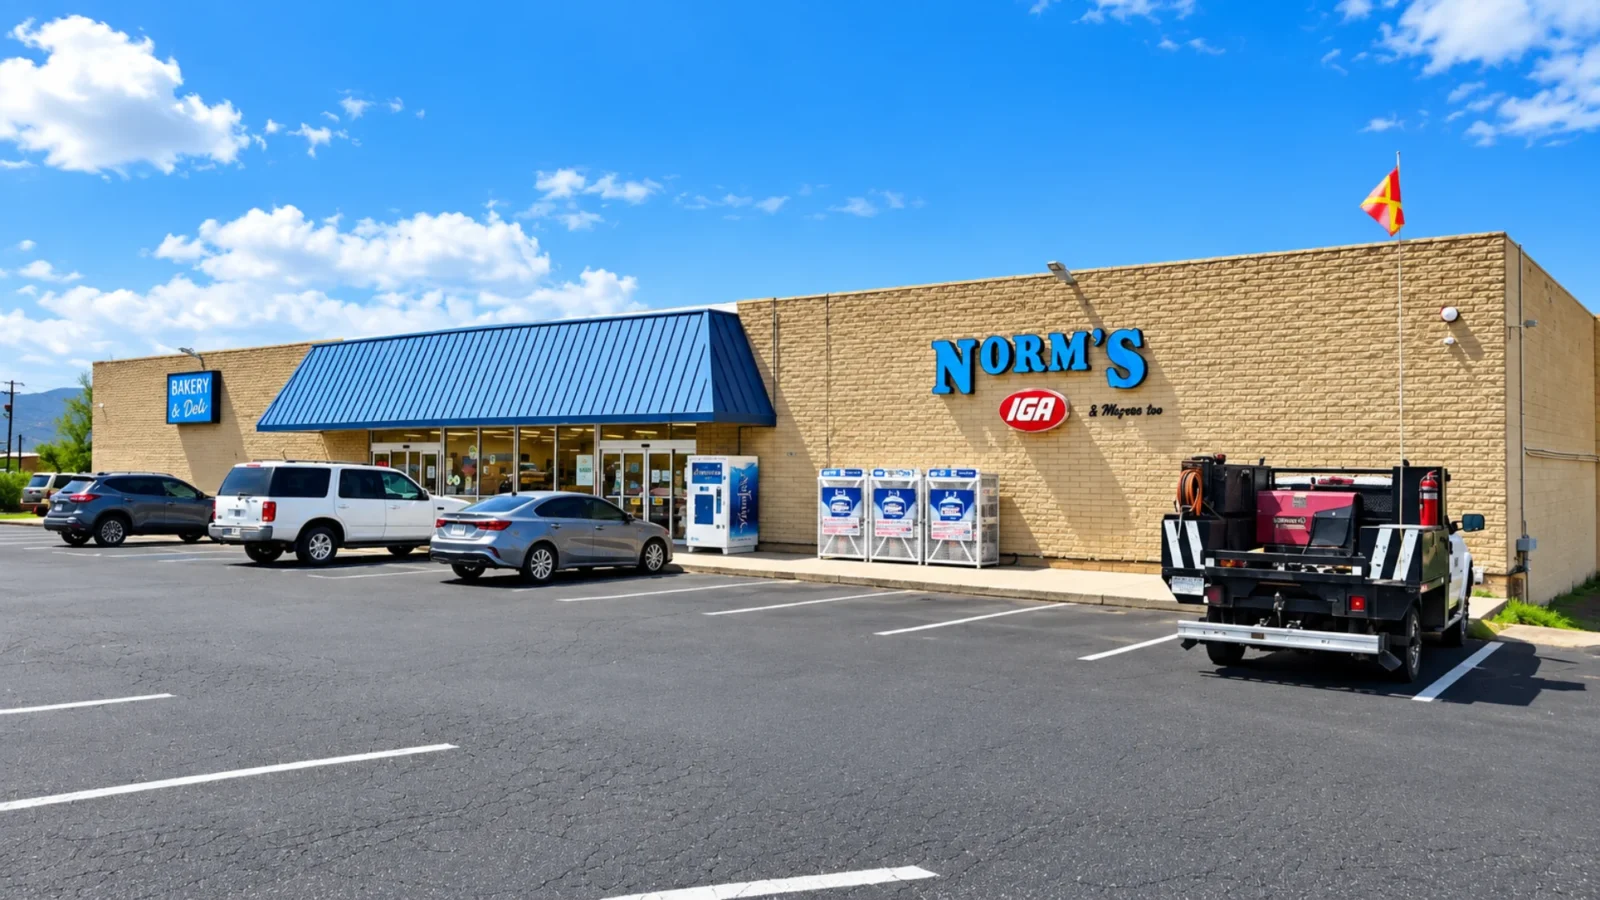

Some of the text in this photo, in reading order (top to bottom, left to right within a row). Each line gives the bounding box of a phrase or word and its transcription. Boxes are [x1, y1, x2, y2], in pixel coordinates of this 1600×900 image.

[932, 328, 1148, 395] NORM'S
[171, 377, 209, 396] BAKERY
[171, 398, 208, 418] & Deli
[1006, 397, 1056, 421] IGA
[1089, 404, 1097, 417] &
[1146, 403, 1163, 416] too
